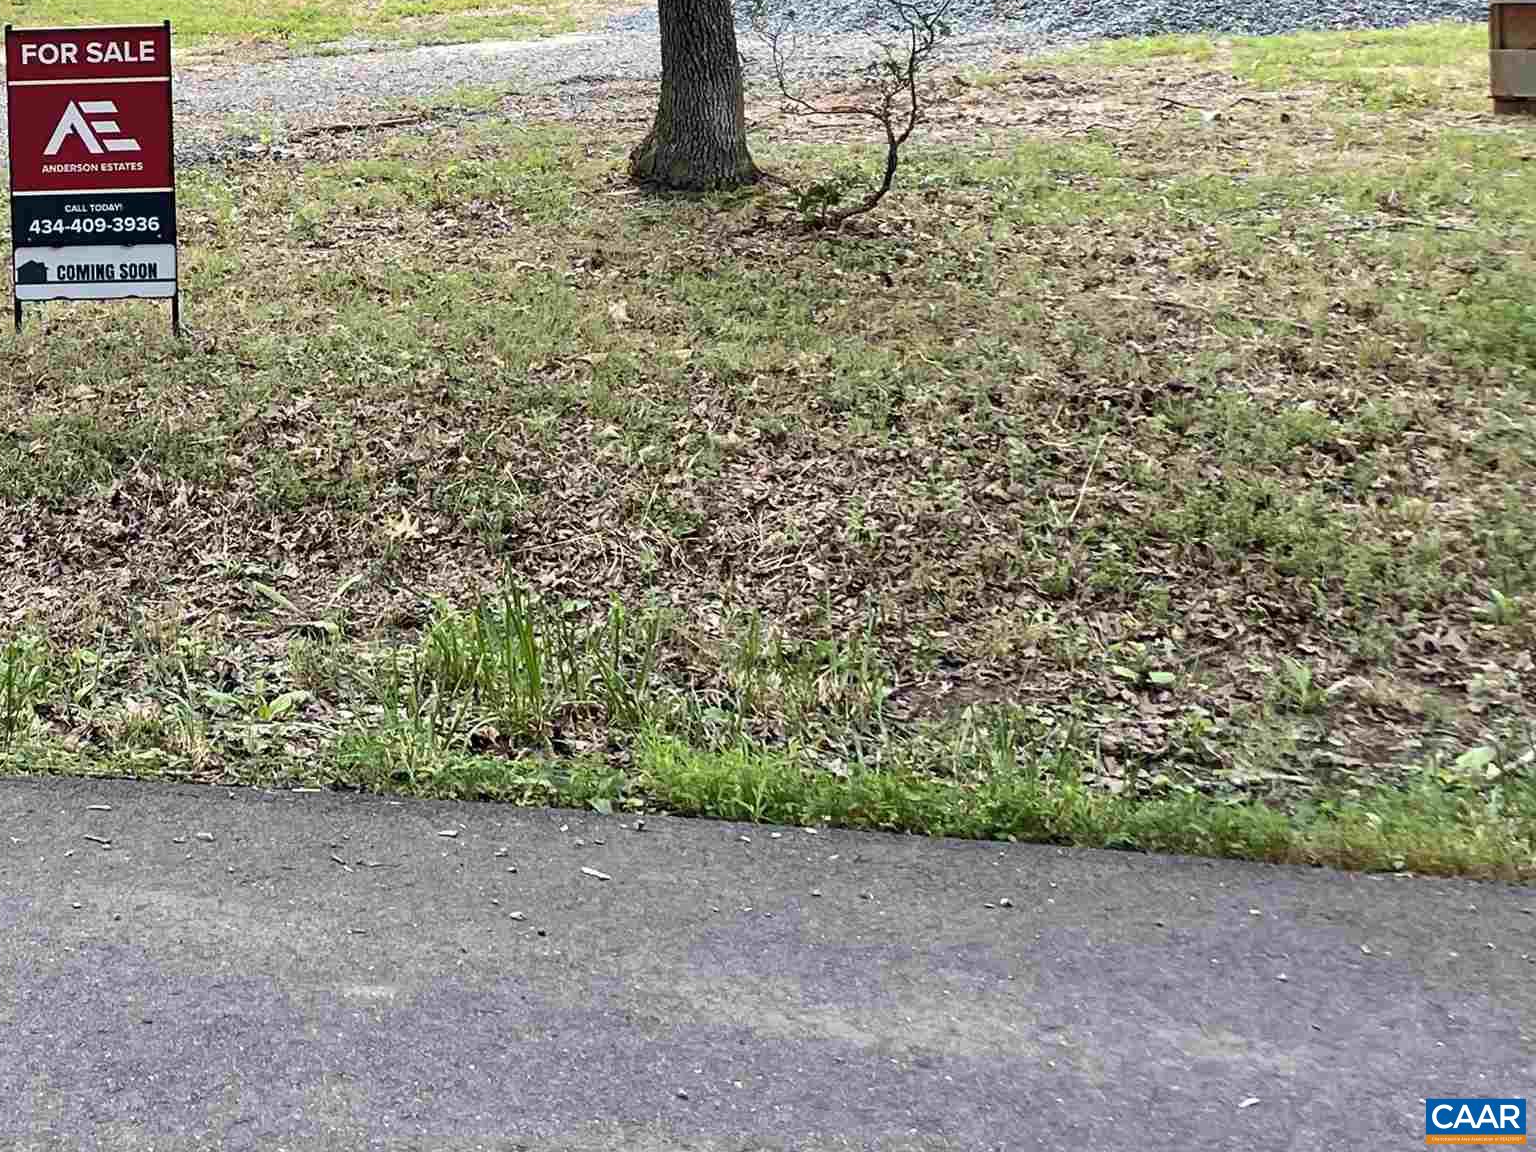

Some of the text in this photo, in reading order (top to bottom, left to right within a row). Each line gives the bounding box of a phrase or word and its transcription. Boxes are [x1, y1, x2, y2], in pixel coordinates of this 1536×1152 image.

[21, 40, 156, 65] FOR SALE
[43, 99, 142, 156] AE
[41, 161, 144, 174] ANDERSON ESTATES
[64, 202, 124, 213] CALL TODAY!
[29, 216, 160, 235] 434-409-3936
[56, 262, 158, 281] COMING SOON
